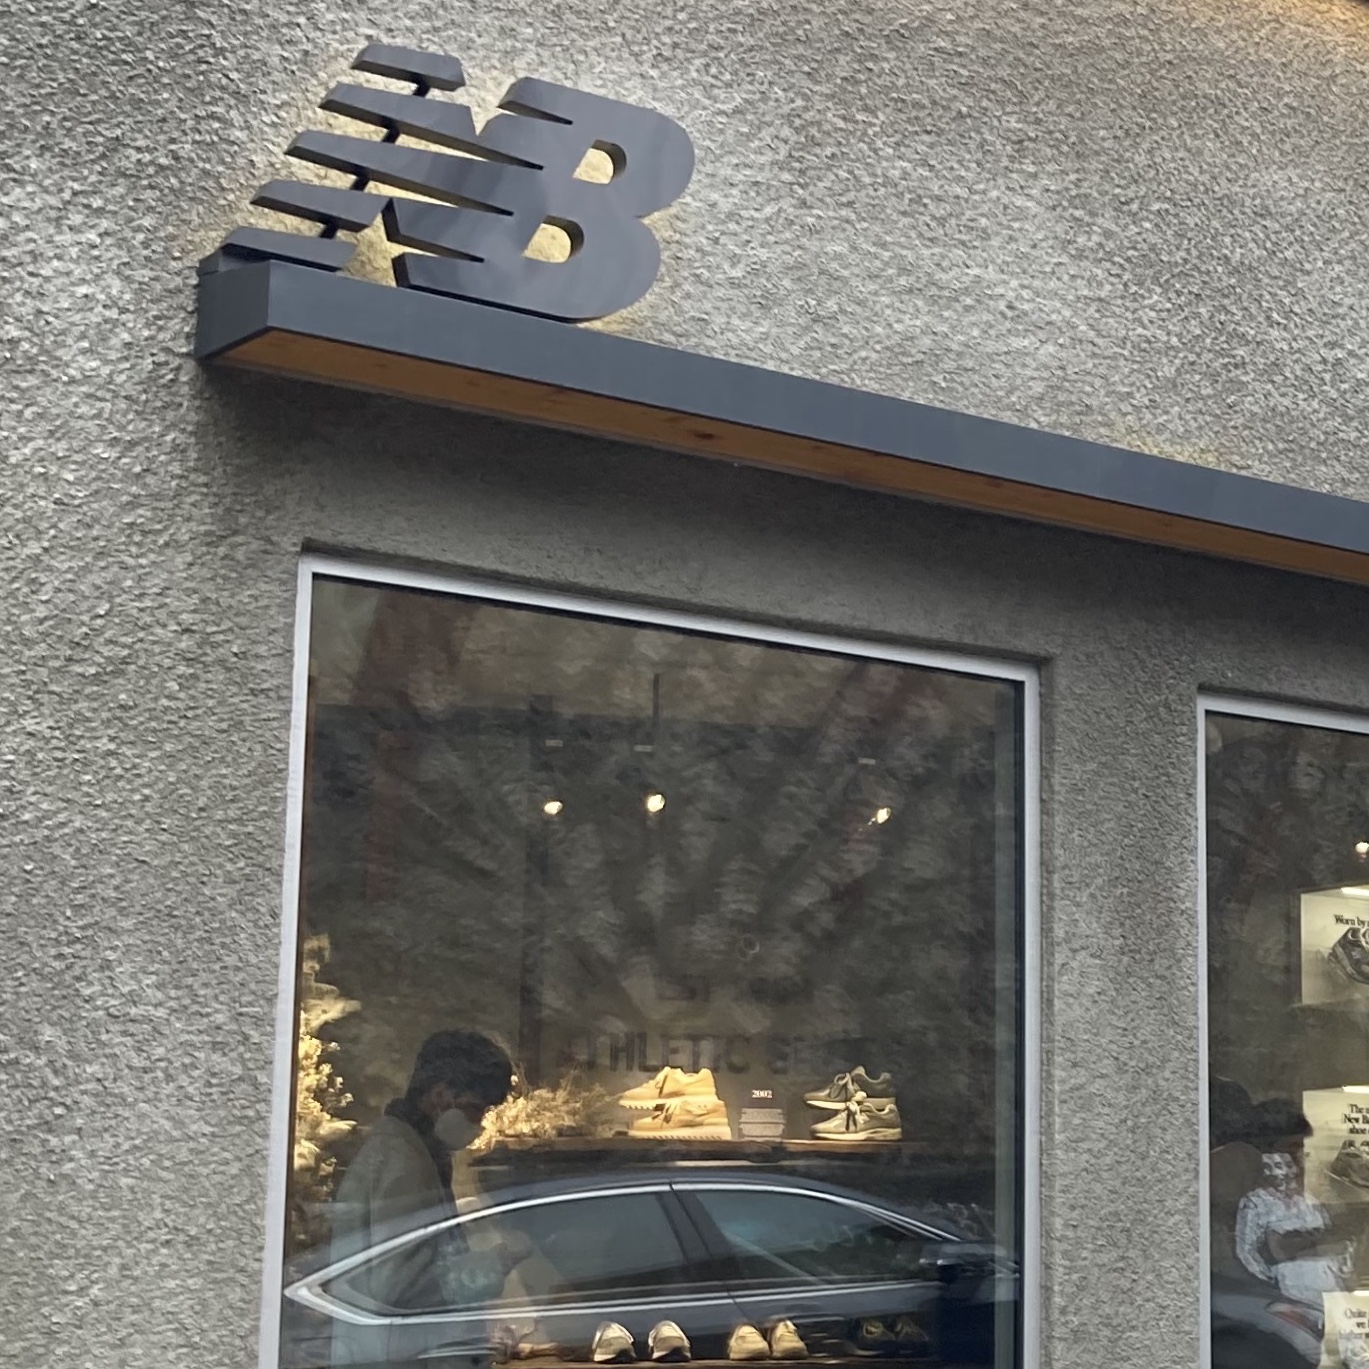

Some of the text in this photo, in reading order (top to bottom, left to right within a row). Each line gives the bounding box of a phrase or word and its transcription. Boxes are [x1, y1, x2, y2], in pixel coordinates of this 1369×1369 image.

[1333, 914, 1355, 926] Worn
[1356, 917, 1366, 929] by
[1349, 1103, 1364, 1114] The
[1343, 1113, 1360, 1124] New
[1349, 1125, 1367, 1135] shoe
[1344, 1308, 1367, 1319] Quite
[1356, 1321, 1367, 1329] we
